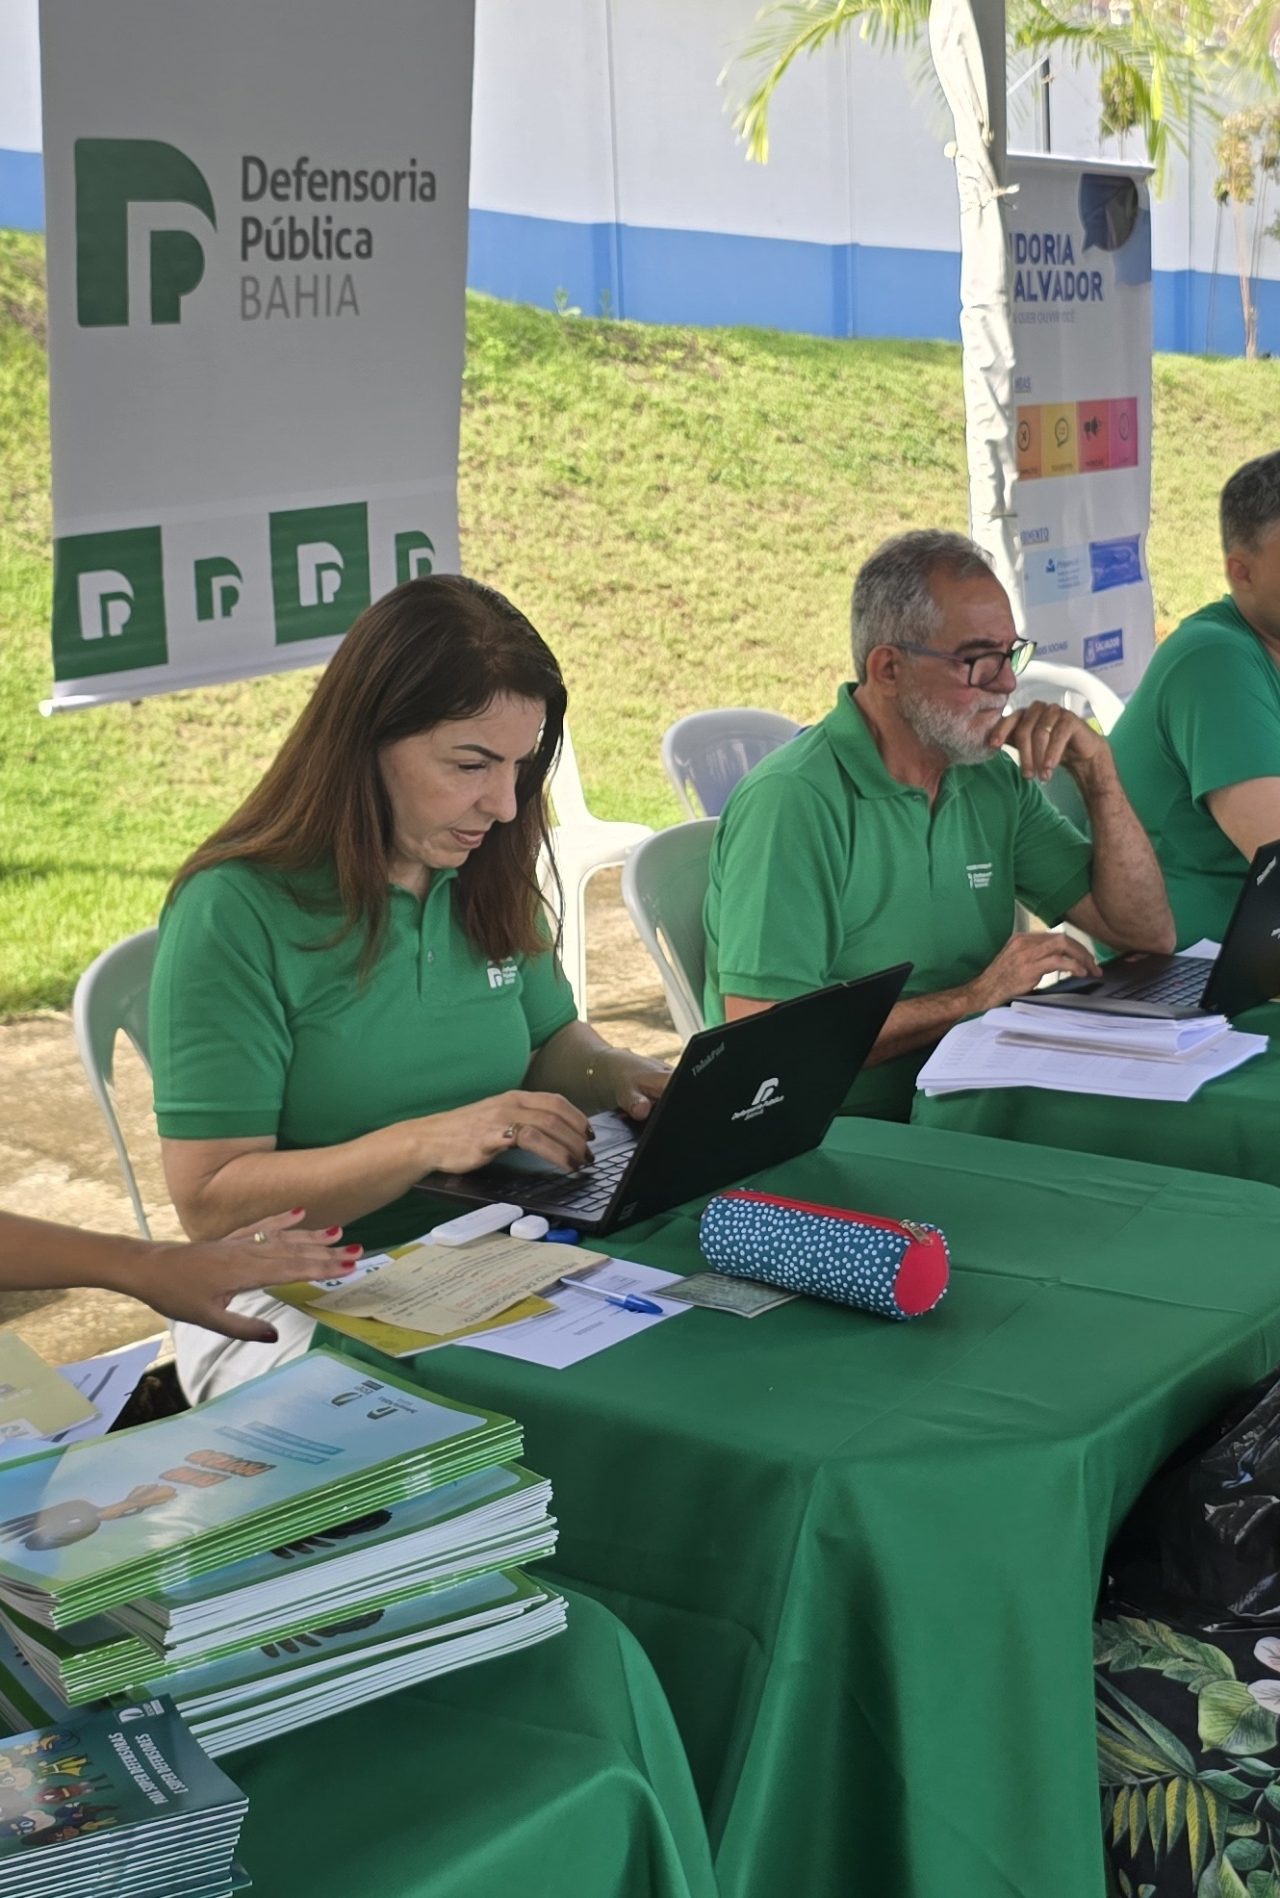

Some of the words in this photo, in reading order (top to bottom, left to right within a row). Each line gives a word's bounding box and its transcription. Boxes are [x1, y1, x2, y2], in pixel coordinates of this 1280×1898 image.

[241, 155, 437, 202] Defensoria
[241, 215, 373, 261] Pública
[240, 273, 361, 321] BAHIA
[1014, 269, 1103, 302] ALVADOR
[108, 1732, 145, 1775] DEFENSORAS
[135, 1733, 172, 1775] DEFENSORES
[133, 1772, 158, 1793] SUPER
[160, 1772, 186, 1790] SUPER
